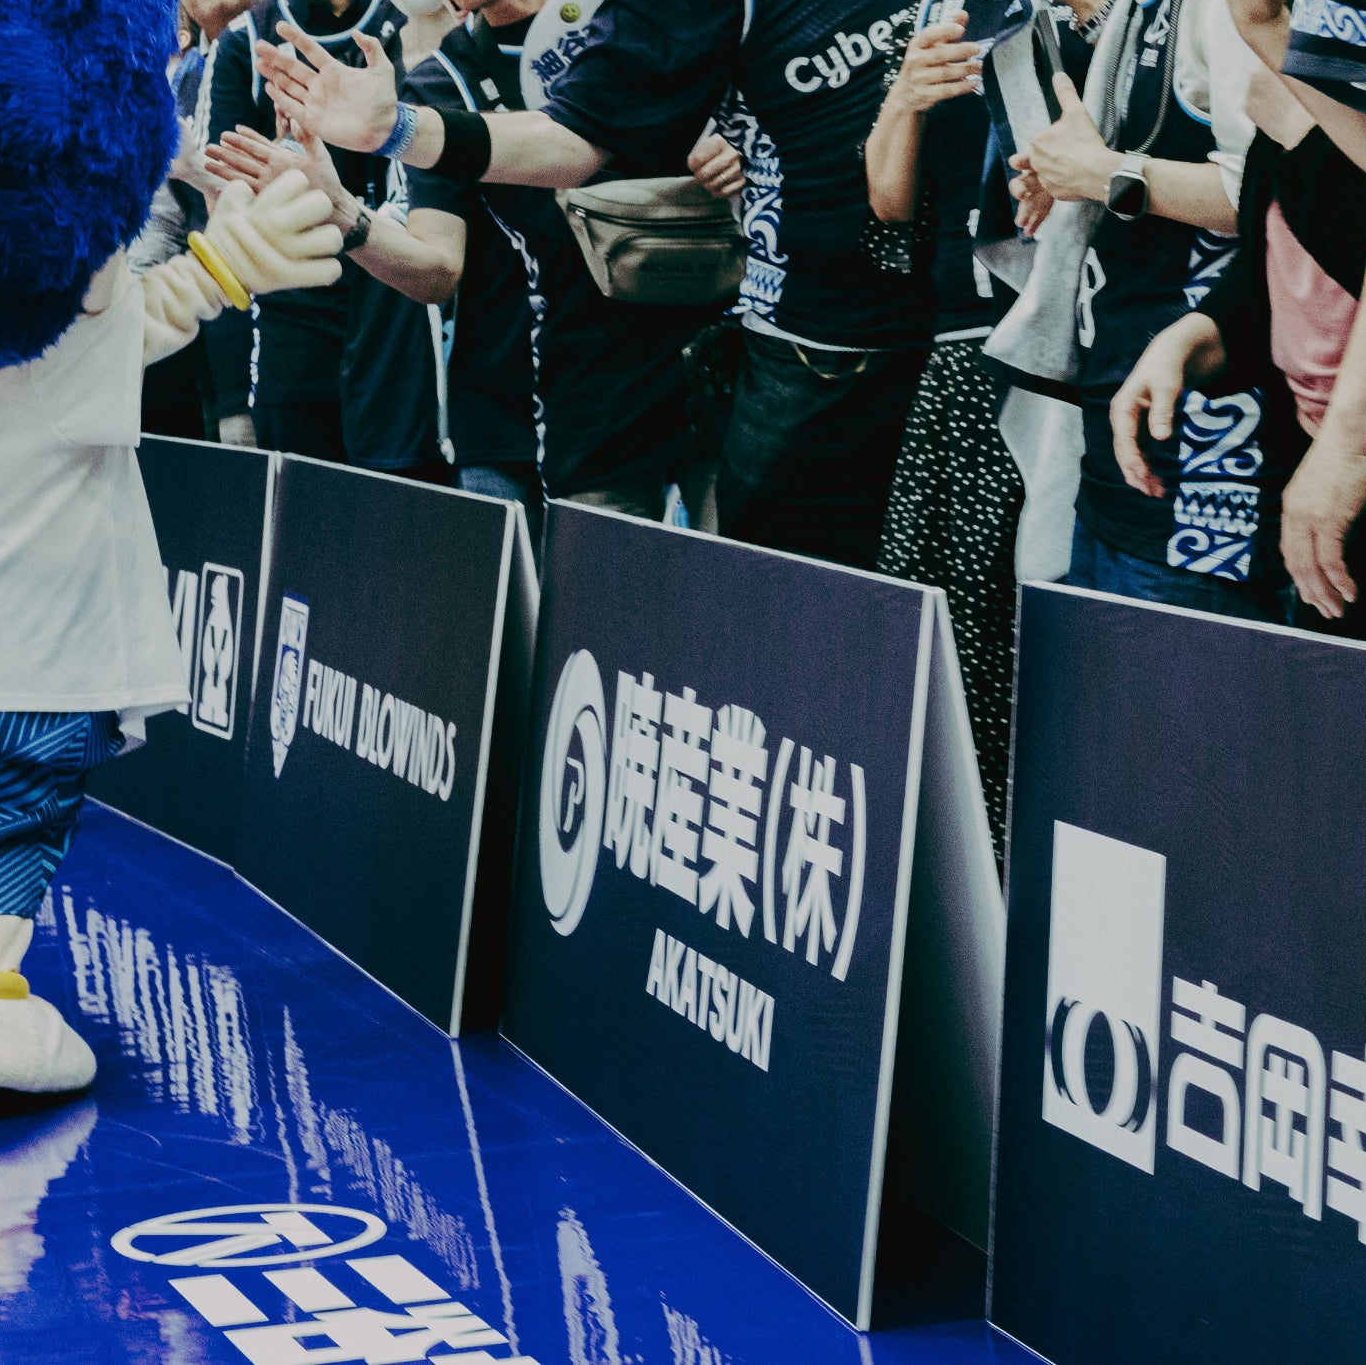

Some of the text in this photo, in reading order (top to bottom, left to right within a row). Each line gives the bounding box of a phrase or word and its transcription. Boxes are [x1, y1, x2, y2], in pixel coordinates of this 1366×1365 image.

[302, 658, 457, 802] FUKUI BLOWINDS
[645, 927, 776, 1073] AKATSUKI
